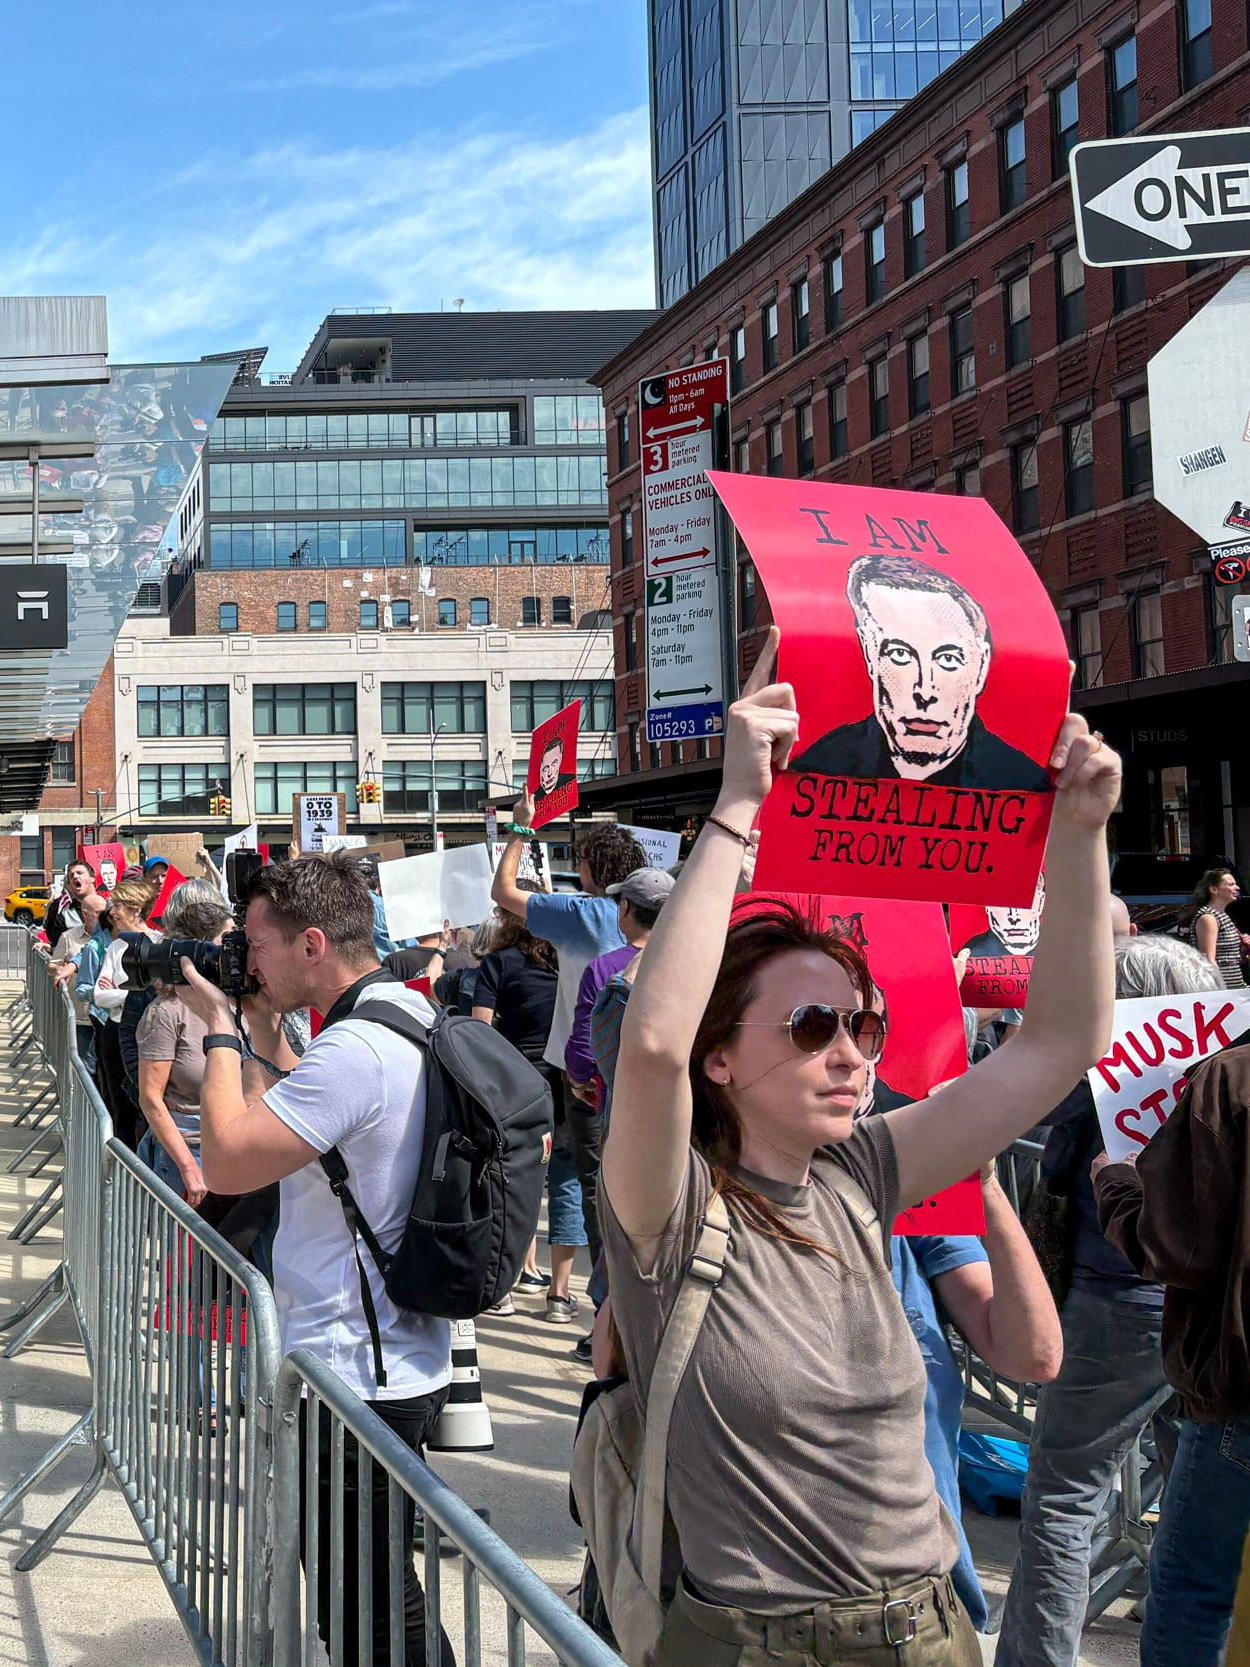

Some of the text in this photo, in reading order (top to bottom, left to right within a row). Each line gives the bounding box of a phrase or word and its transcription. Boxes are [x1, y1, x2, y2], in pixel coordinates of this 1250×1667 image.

[1134, 170, 1250, 221] ONE
[668, 366, 722, 388] NO STANDING
[669, 393, 684, 404] 11pm
[690, 388, 705, 398] 6am
[669, 402, 696, 415] All Days
[671, 440, 687, 450] hour
[672, 445, 700, 458] metered
[650, 446, 663, 472] 3
[672, 455, 697, 469] parking
[1180, 445, 1227, 475] SHANGEN
[648, 473, 708, 496] COMMERCIAL
[648, 486, 714, 511] VEHICLES ONL
[649, 523, 678, 536] Monday
[686, 516, 710, 529] Friday
[798, 507, 950, 555] I AM
[650, 539, 666, 549] 7am
[674, 534, 692, 546] 4pm
[1210, 545, 1250, 560] Please
[676, 573, 692, 582] hour
[653, 578, 667, 604] 2
[676, 579, 706, 592] metered
[676, 590, 702, 602] parking
[650, 613, 681, 626] Monday
[688, 607, 714, 620] Friday
[651, 628, 668, 638] 4pm
[676, 623, 694, 635] 11pm
[651, 642, 686, 656] Saturday
[652, 657, 666, 668] 7am
[674, 654, 692, 665] 11pm
[650, 720, 696, 738] 105293
[1138, 729, 1188, 743] STUDS
[316, 801, 332, 810] TO
[790, 775, 1026, 836] STEALING
[306, 810, 332, 818] 1939
[95, 850, 100, 858] I
[808, 828, 994, 875] FROM YOU.
[1095, 1001, 1235, 1093] MUSK
